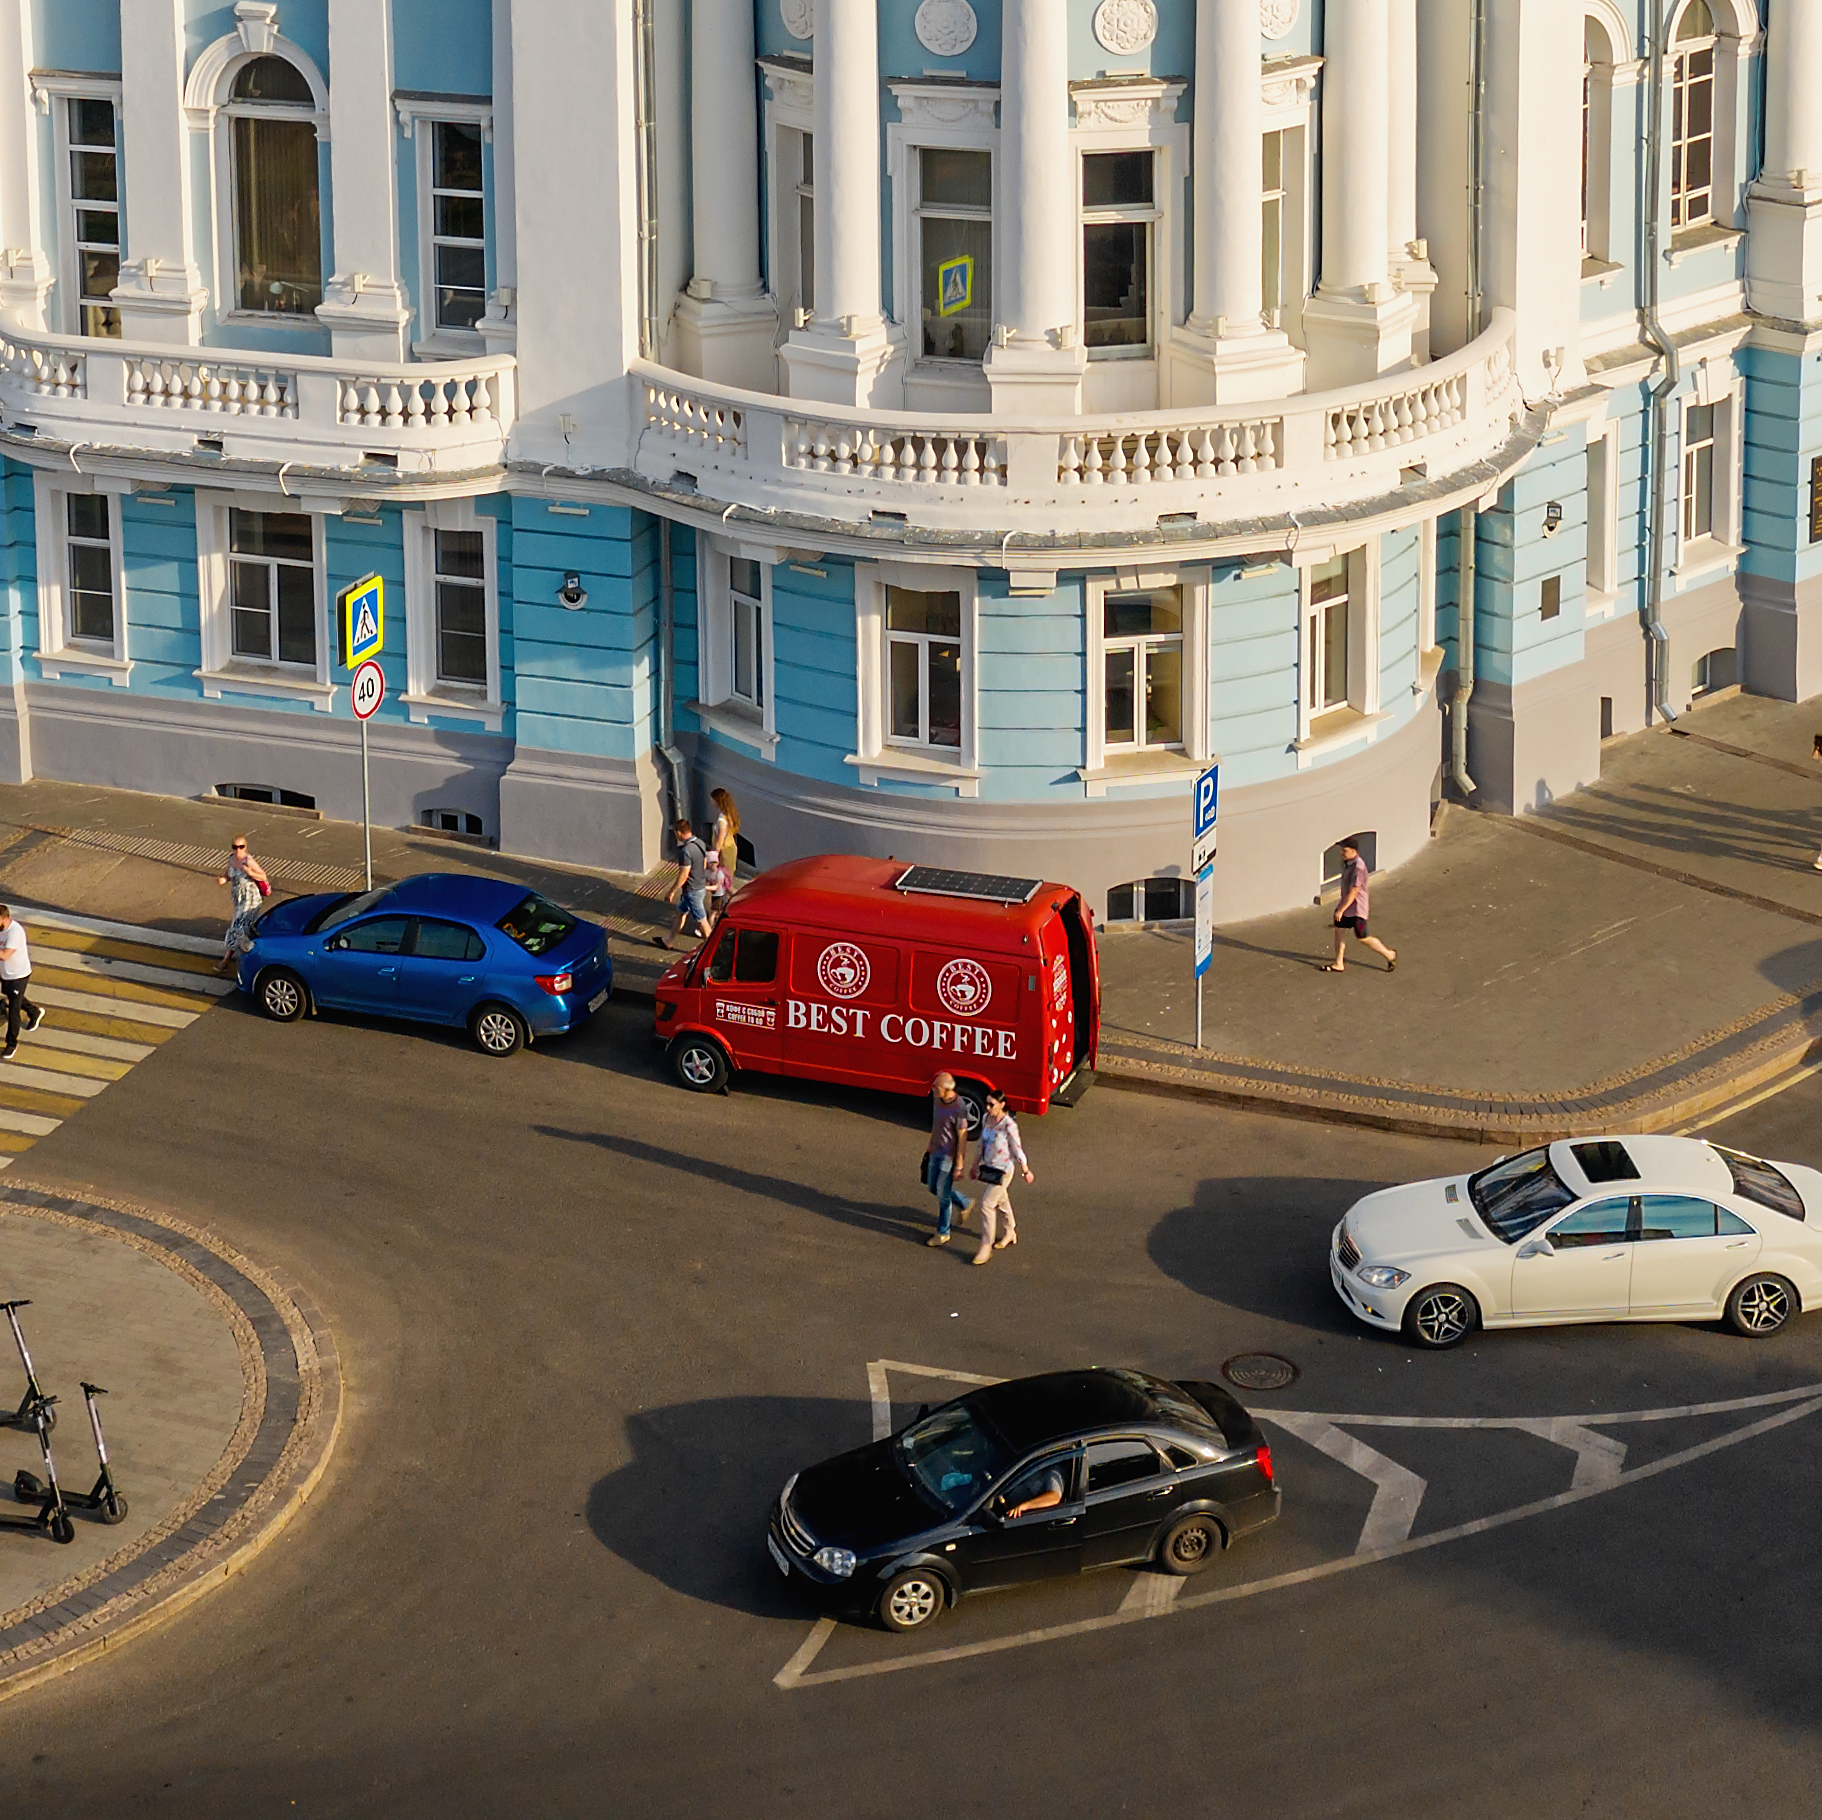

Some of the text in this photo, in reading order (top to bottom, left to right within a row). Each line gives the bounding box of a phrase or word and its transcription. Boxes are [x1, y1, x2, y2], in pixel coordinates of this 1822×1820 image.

[358, 677, 375, 703] 40
[1199, 776, 1214, 828] P
[829, 945, 859, 959] BEST
[949, 962, 979, 975] BEST
[829, 983, 857, 995] COFFEE
[949, 1000, 977, 1012] COFFEE
[786, 999, 1017, 1061] BEST COFFEE
